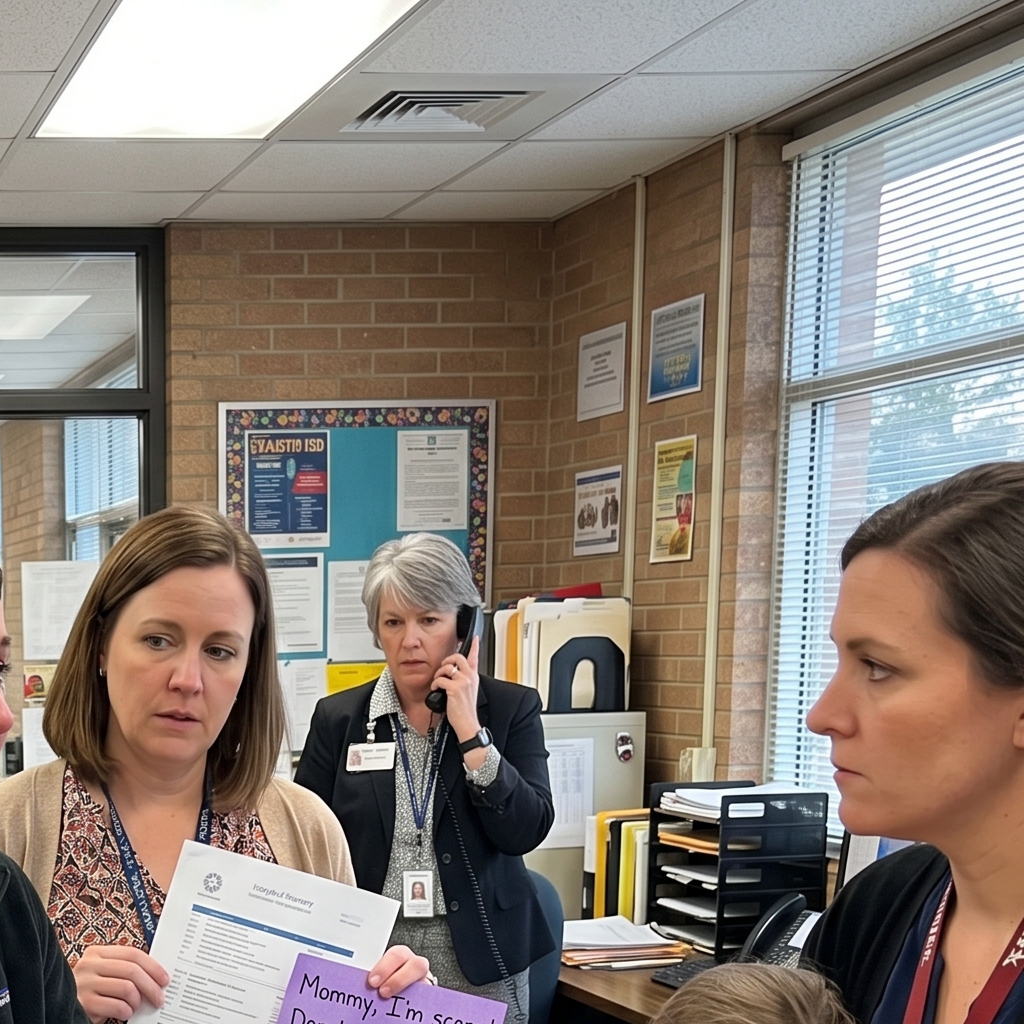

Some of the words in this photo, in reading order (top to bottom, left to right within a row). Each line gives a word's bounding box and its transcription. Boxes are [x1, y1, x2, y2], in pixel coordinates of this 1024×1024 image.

[304, 438, 324, 452] ISD
[299, 973, 377, 1021] Mommy,
[385, 996, 423, 1023] I'm
